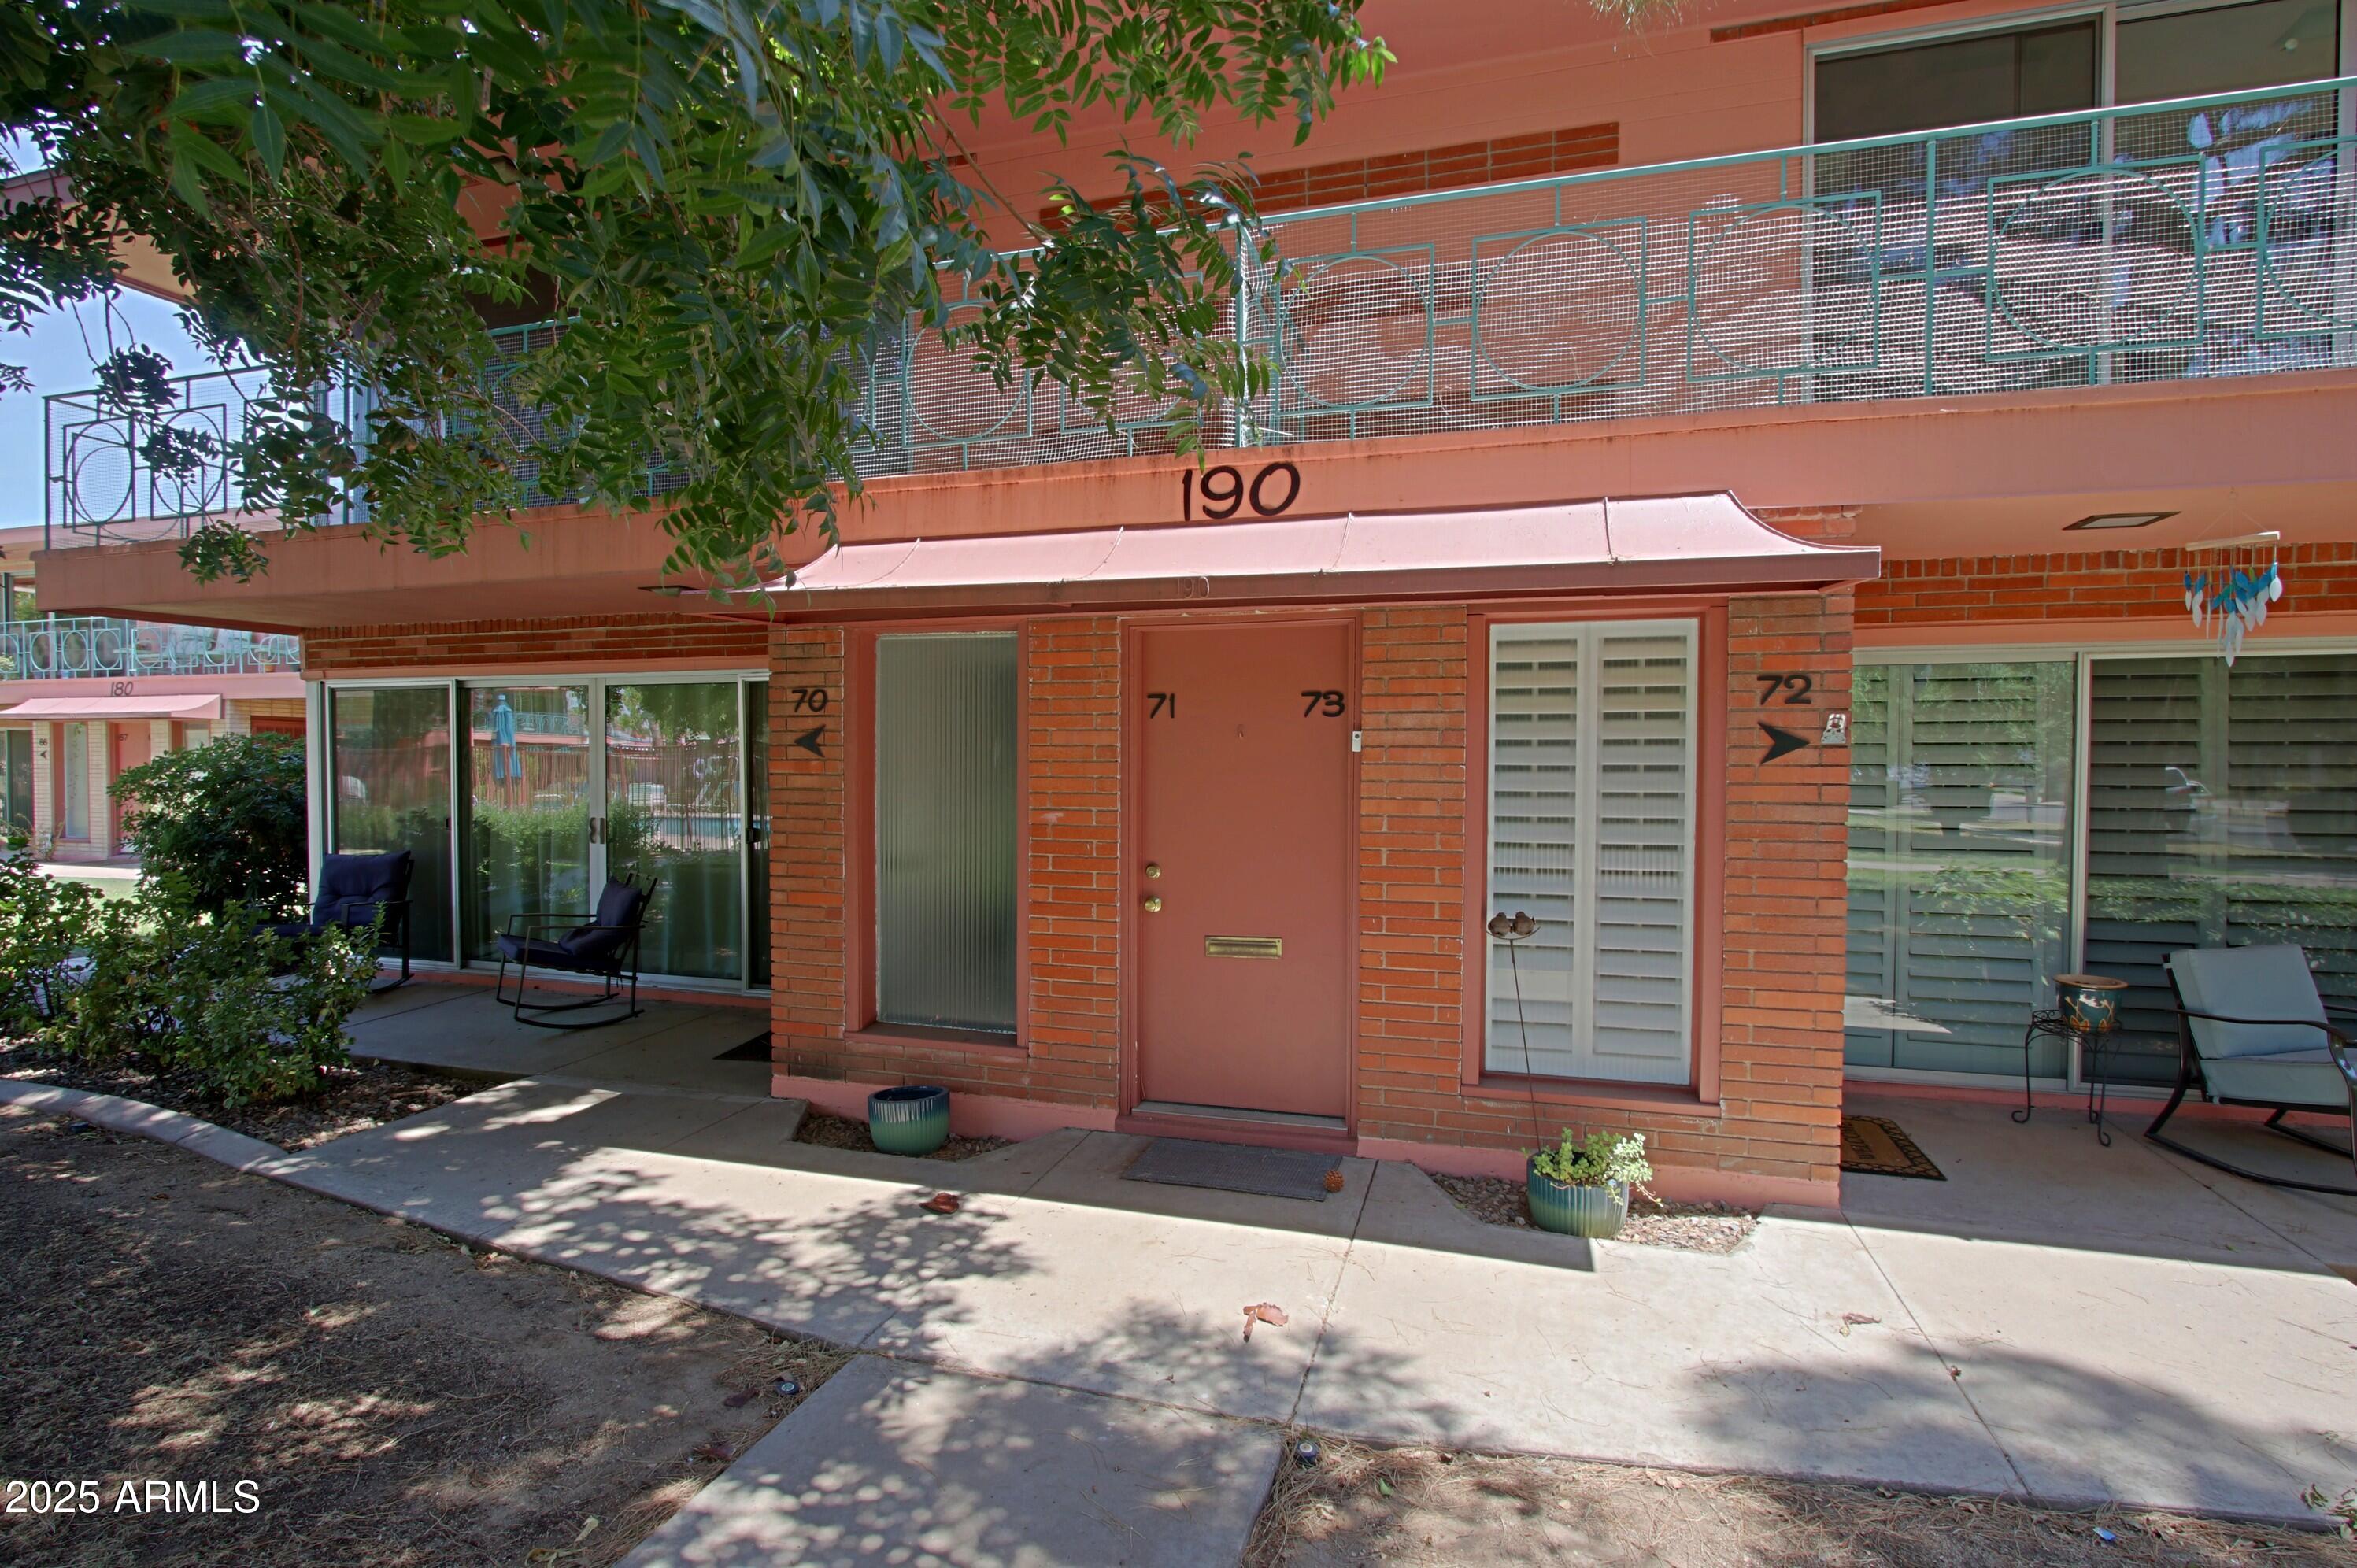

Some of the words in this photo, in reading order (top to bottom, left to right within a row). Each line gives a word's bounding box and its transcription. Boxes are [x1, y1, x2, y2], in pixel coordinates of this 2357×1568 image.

[1182, 462, 1301, 521] 190
[1177, 576, 1210, 599] 190
[110, 681, 134, 697] 180
[791, 688, 827, 712] 70
[1756, 675, 1812, 705] 72
[1147, 693, 1175, 719] 71
[1301, 690, 1345, 718] 73
